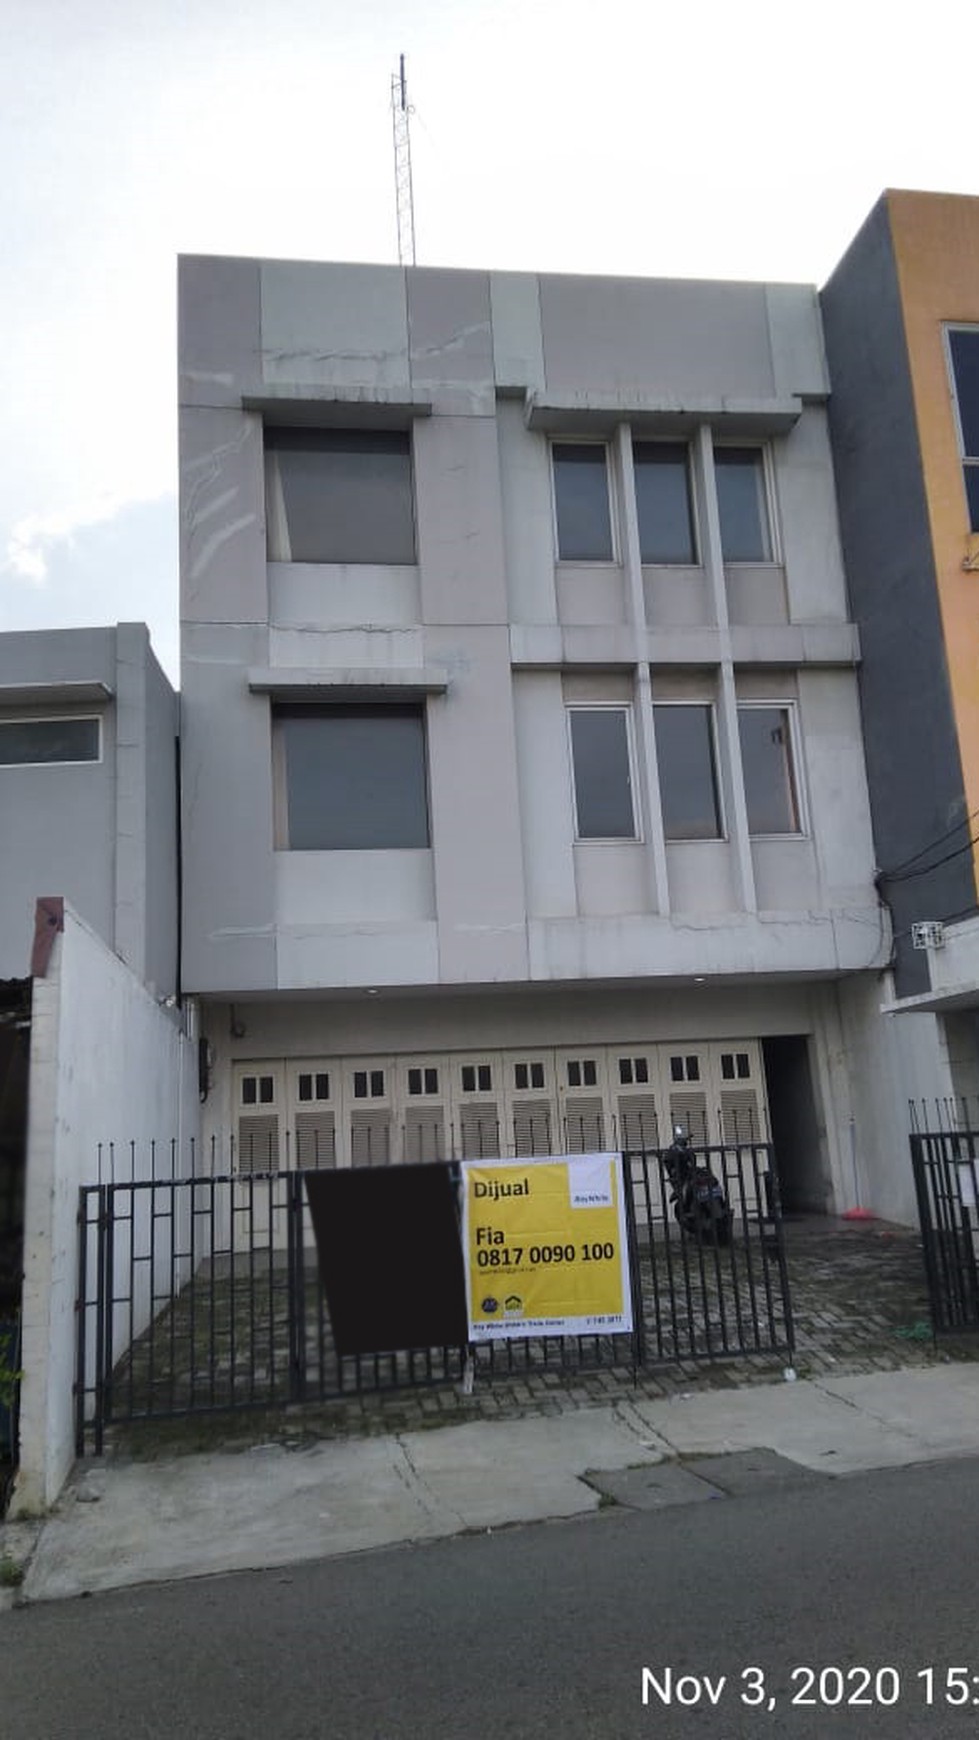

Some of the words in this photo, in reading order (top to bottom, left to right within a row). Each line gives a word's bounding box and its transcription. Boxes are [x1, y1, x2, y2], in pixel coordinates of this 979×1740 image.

[474, 1178, 529, 1201] Dijual
[476, 1227, 505, 1246] Fia
[477, 1248, 523, 1267] 0817
[529, 1244, 576, 1264] 0090
[582, 1242, 614, 1261] 100
